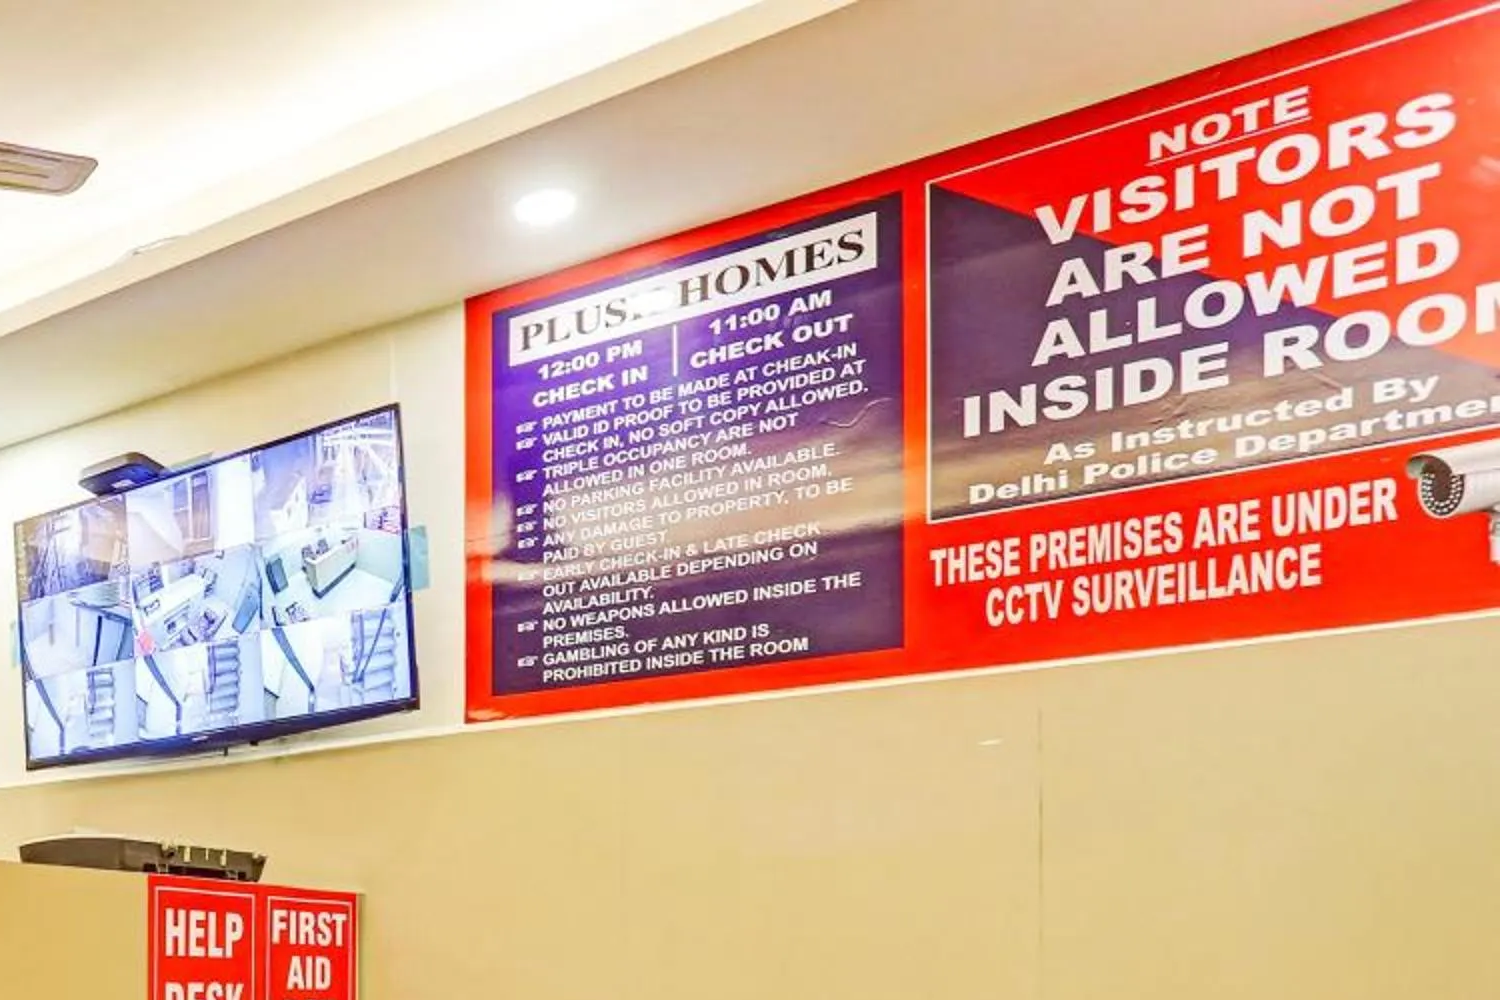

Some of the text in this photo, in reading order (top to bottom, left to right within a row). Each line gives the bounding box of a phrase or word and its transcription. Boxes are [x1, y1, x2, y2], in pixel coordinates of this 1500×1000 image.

[1149, 86, 1310, 160] NOTE
[1034, 92, 1457, 246] VISITORS
[1046, 162, 1442, 308] ARE NOT
[520, 298, 627, 350] PLUS
[679, 229, 864, 306] HOMES
[709, 290, 831, 334] 11:00 AM
[1031, 227, 1460, 367] ALLOWED
[538, 340, 642, 380] 12:00 PM
[690, 314, 853, 368] CHECK OUT
[533, 366, 647, 407] CHECK IN
[542, 342, 857, 430] PAYMENT TO BE MADE AT CHEAK-IN
[542, 359, 866, 446] VALID ID PROOF TO BE PROVIDED AT
[963, 343, 1229, 438] INSIDE
[542, 440, 599, 463] CHECK
[629, 427, 654, 444] NO
[659, 415, 705, 437] SOFT
[709, 401, 762, 425] COPY
[765, 379, 868, 413] ALLOWED.
[542, 412, 799, 480] TRIPLE OCCUPANCY ARE NOT
[1044, 375, 1440, 465] As Instructed By
[542, 442, 751, 497] ALLOWED IN ONE ROOM.
[543, 443, 840, 514] NO PARKING FACILITY AVAILABLE.
[543, 463, 832, 530] NO VISITORS ALLOWED IN ROOM.
[969, 470, 1069, 506] Delhi
[1084, 446, 1217, 487] Police
[543, 530, 575, 547] ANY
[581, 516, 652, 541] DAMAGE
[658, 510, 682, 525] TO
[793, 484, 820, 499] TO
[826, 478, 853, 495] BE
[930, 477, 1398, 587] THESE PREMISES ARE UNDER
[543, 522, 821, 580] EARLY CHECK-IN & LATE CHECK
[543, 547, 579, 564] PAID
[583, 542, 606, 557] BY
[543, 541, 818, 597] OUT AVAILABLE DEPENDING ON
[543, 587, 653, 615] AVAILABILITY.
[543, 572, 862, 632] NO WEAPONS ALLOWED INSIDE THE
[985, 544, 1323, 627] CCTV SURVEILLANCE
[543, 626, 629, 649] PREMISES.
[543, 623, 770, 666] GAMBLING OF ANY KIND IS
[543, 637, 809, 683] PROHIBITED INSIDE THE ROOM
[165, 907, 244, 958] HELP
[272, 909, 348, 947] FIRST
[287, 955, 331, 990] AID
